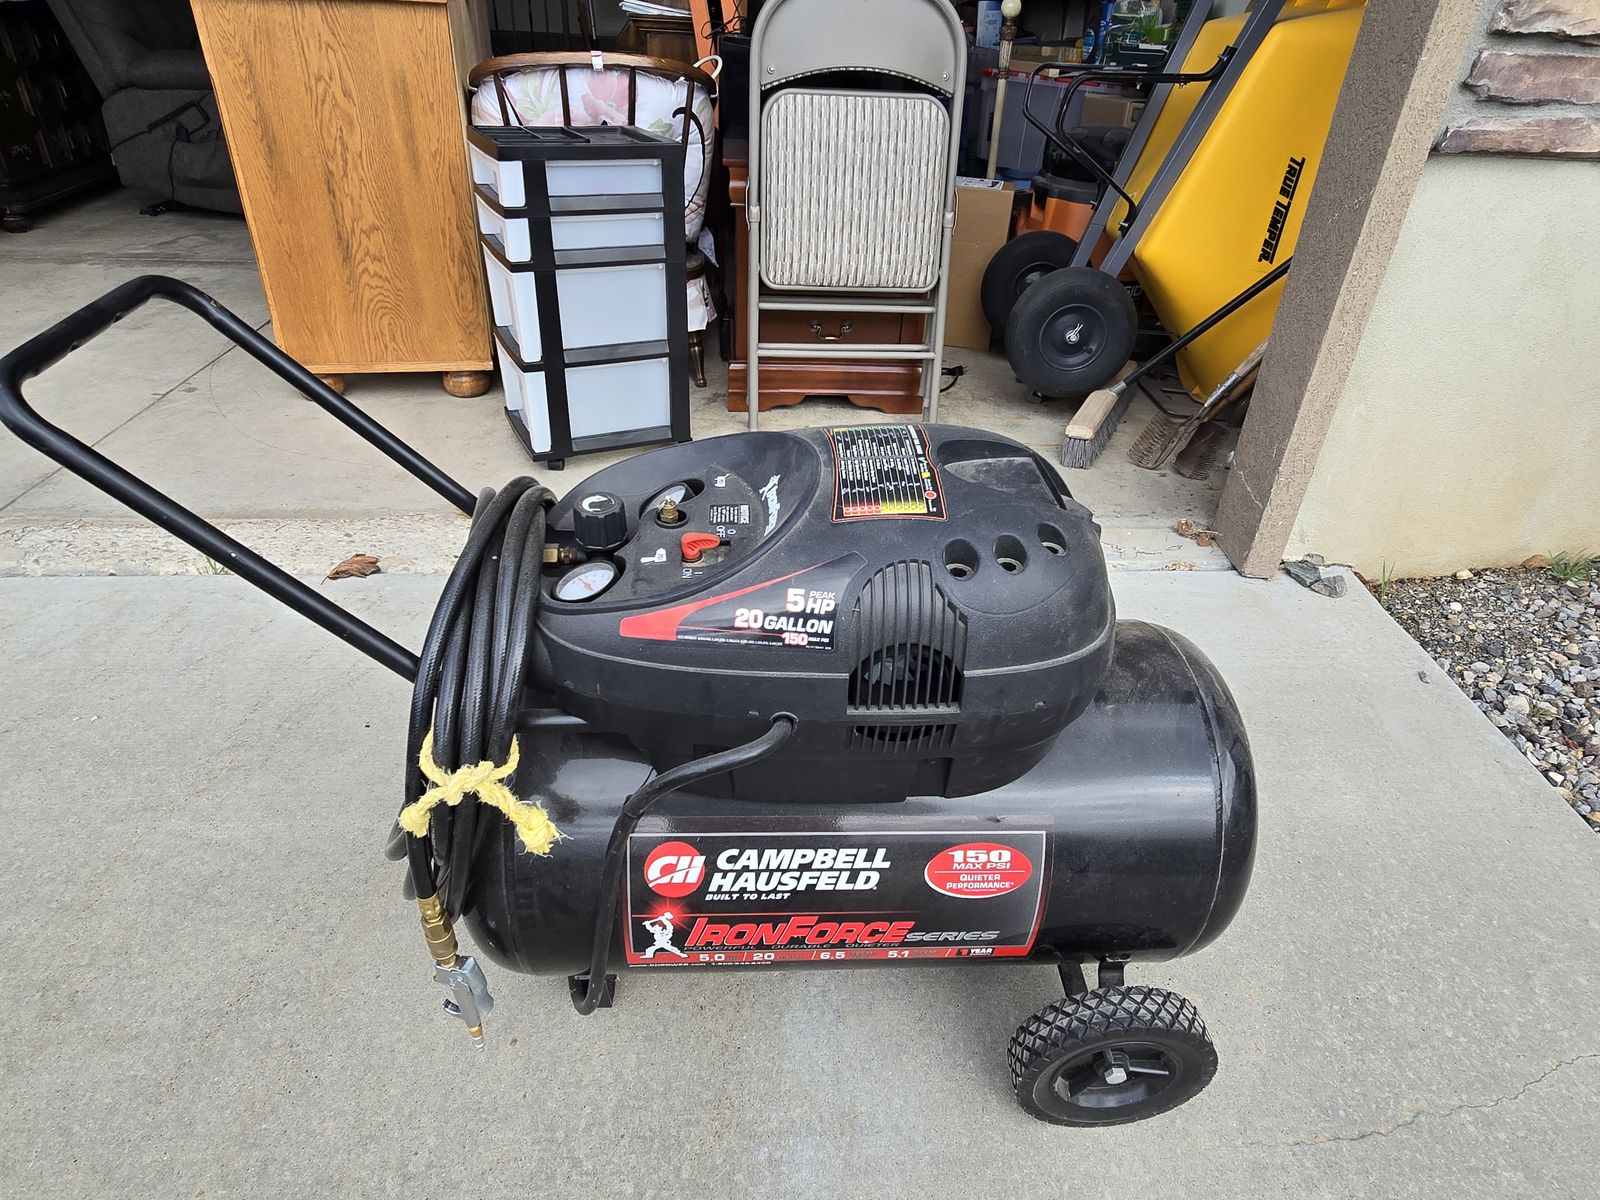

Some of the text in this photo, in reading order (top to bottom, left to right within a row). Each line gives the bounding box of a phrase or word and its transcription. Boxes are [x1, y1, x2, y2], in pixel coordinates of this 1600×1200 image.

[1258, 156, 1306, 265] TRUE TEMPER
[716, 525, 726, 538] OFF
[681, 567, 693, 579] ON
[786, 587, 836, 613] 5 PEAK
[805, 598, 836, 615] HP
[733, 607, 834, 635] 20 GALLON
[781, 632, 809, 646] 150
[716, 848, 892, 871] CAMPBELL
[947, 850, 1011, 863] 150
[952, 862, 1011, 870] MAX PSI
[707, 870, 881, 893] HAUSFELD
[959, 873, 1001, 882] QUIETER
[704, 893, 740, 901] BUILT
[760, 892, 791, 900] LAST
[904, 930, 1001, 942] SERIES
[698, 952, 726, 962] 5.0
[752, 952, 775, 961] 20
[819, 951, 846, 960] 6.5
[887, 950, 910, 958] 5.1
[969, 947, 994, 955] YEAR
